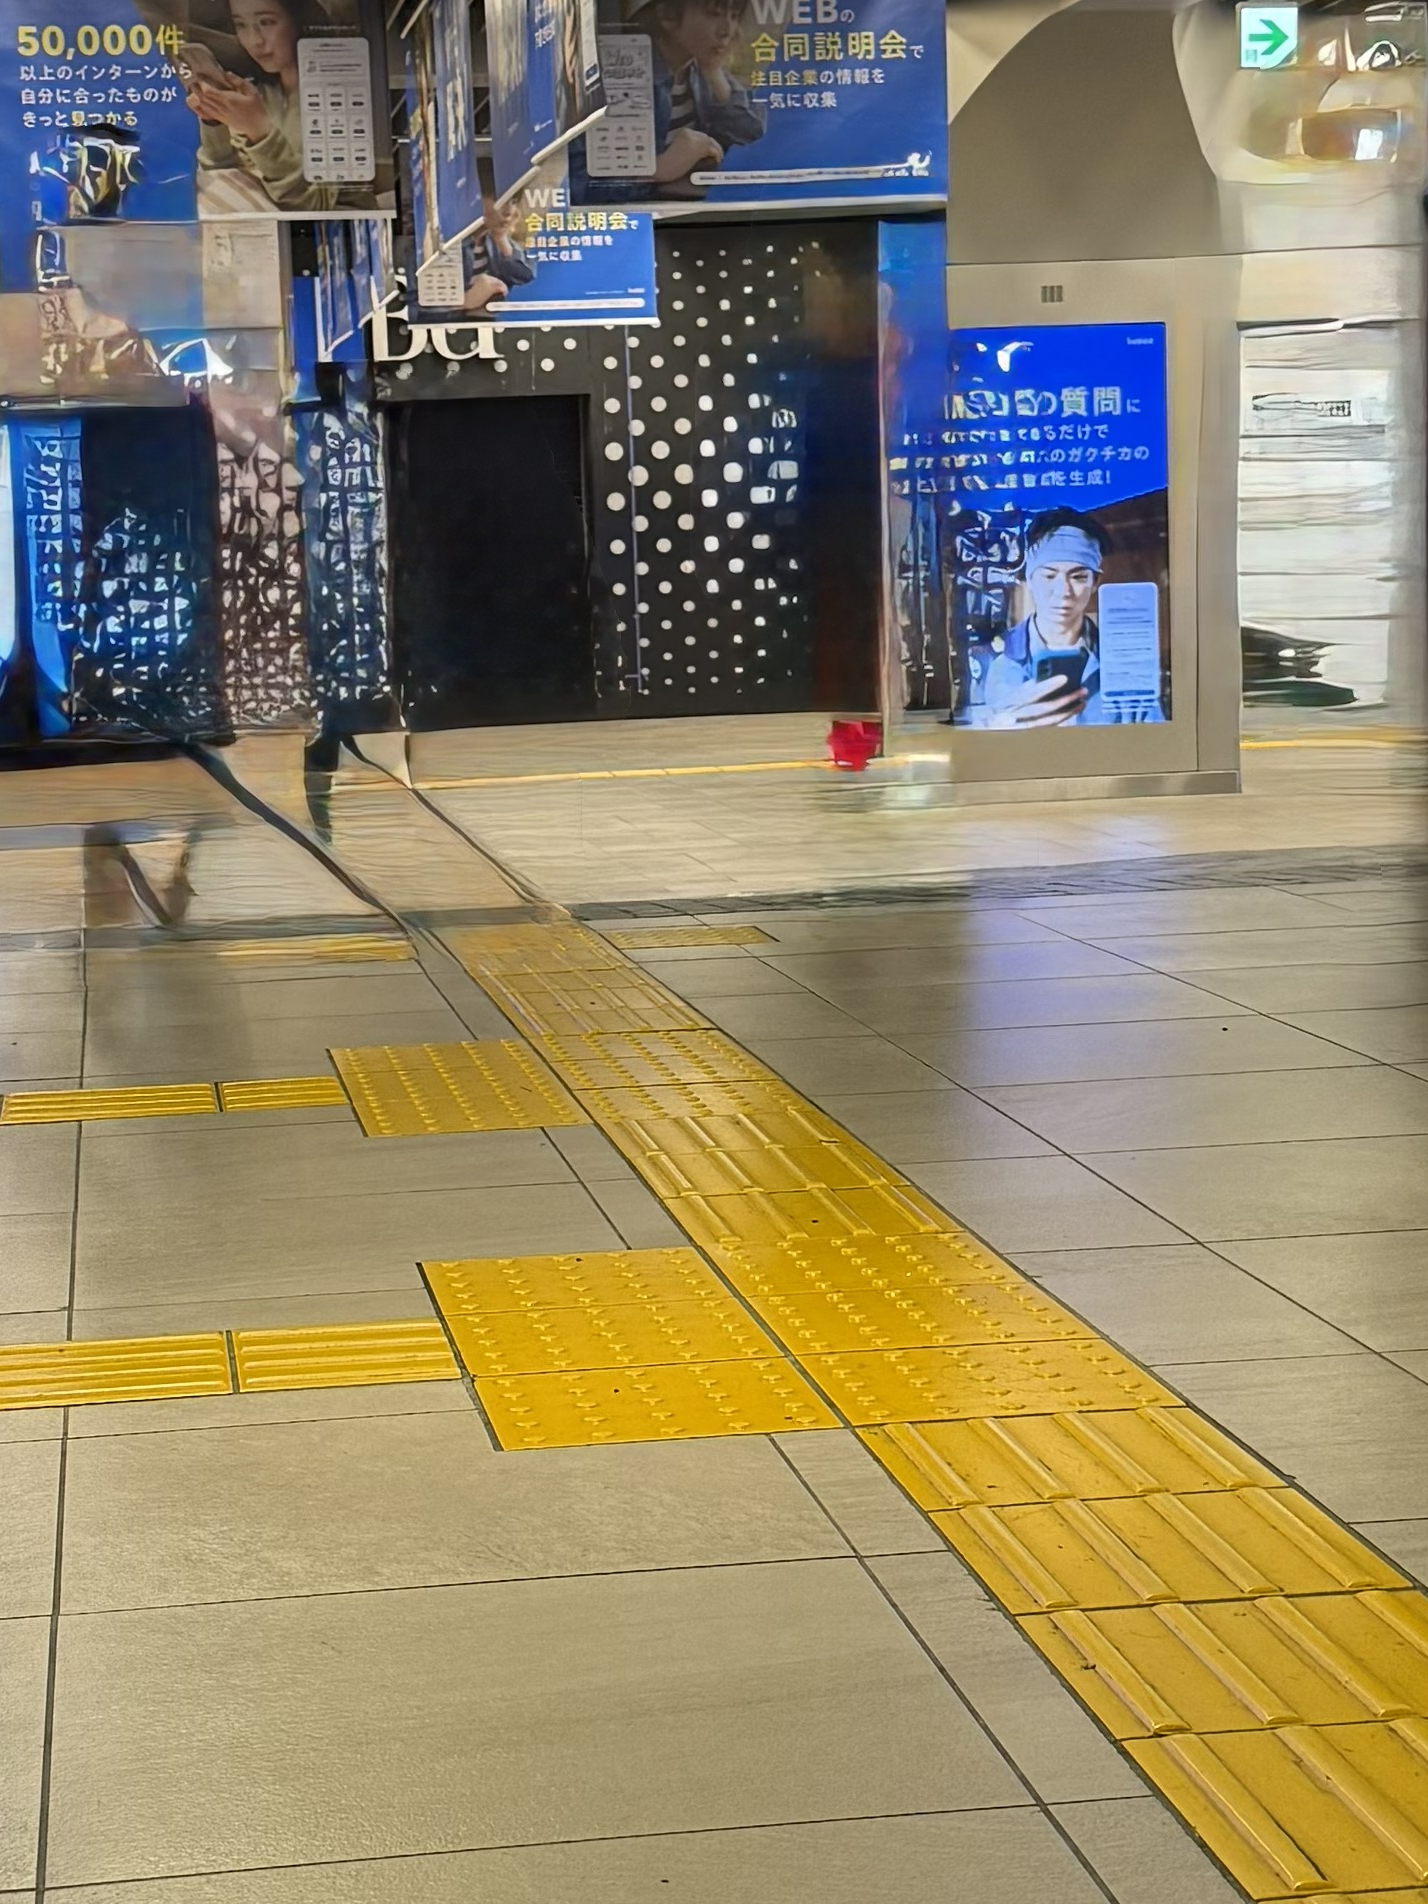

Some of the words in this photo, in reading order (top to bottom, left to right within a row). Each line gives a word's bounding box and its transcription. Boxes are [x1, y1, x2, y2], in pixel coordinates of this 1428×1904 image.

[17, 23, 185, 60] 50,000件
[749, 30, 925, 63] 合同説明会で
[20, 63, 194, 81] 以上のインターンから
[750, 68, 885, 87] 注目企業の情報を
[21, 86, 178, 105] 自分に合ったものが
[752, 91, 837, 109] 一気に収集
